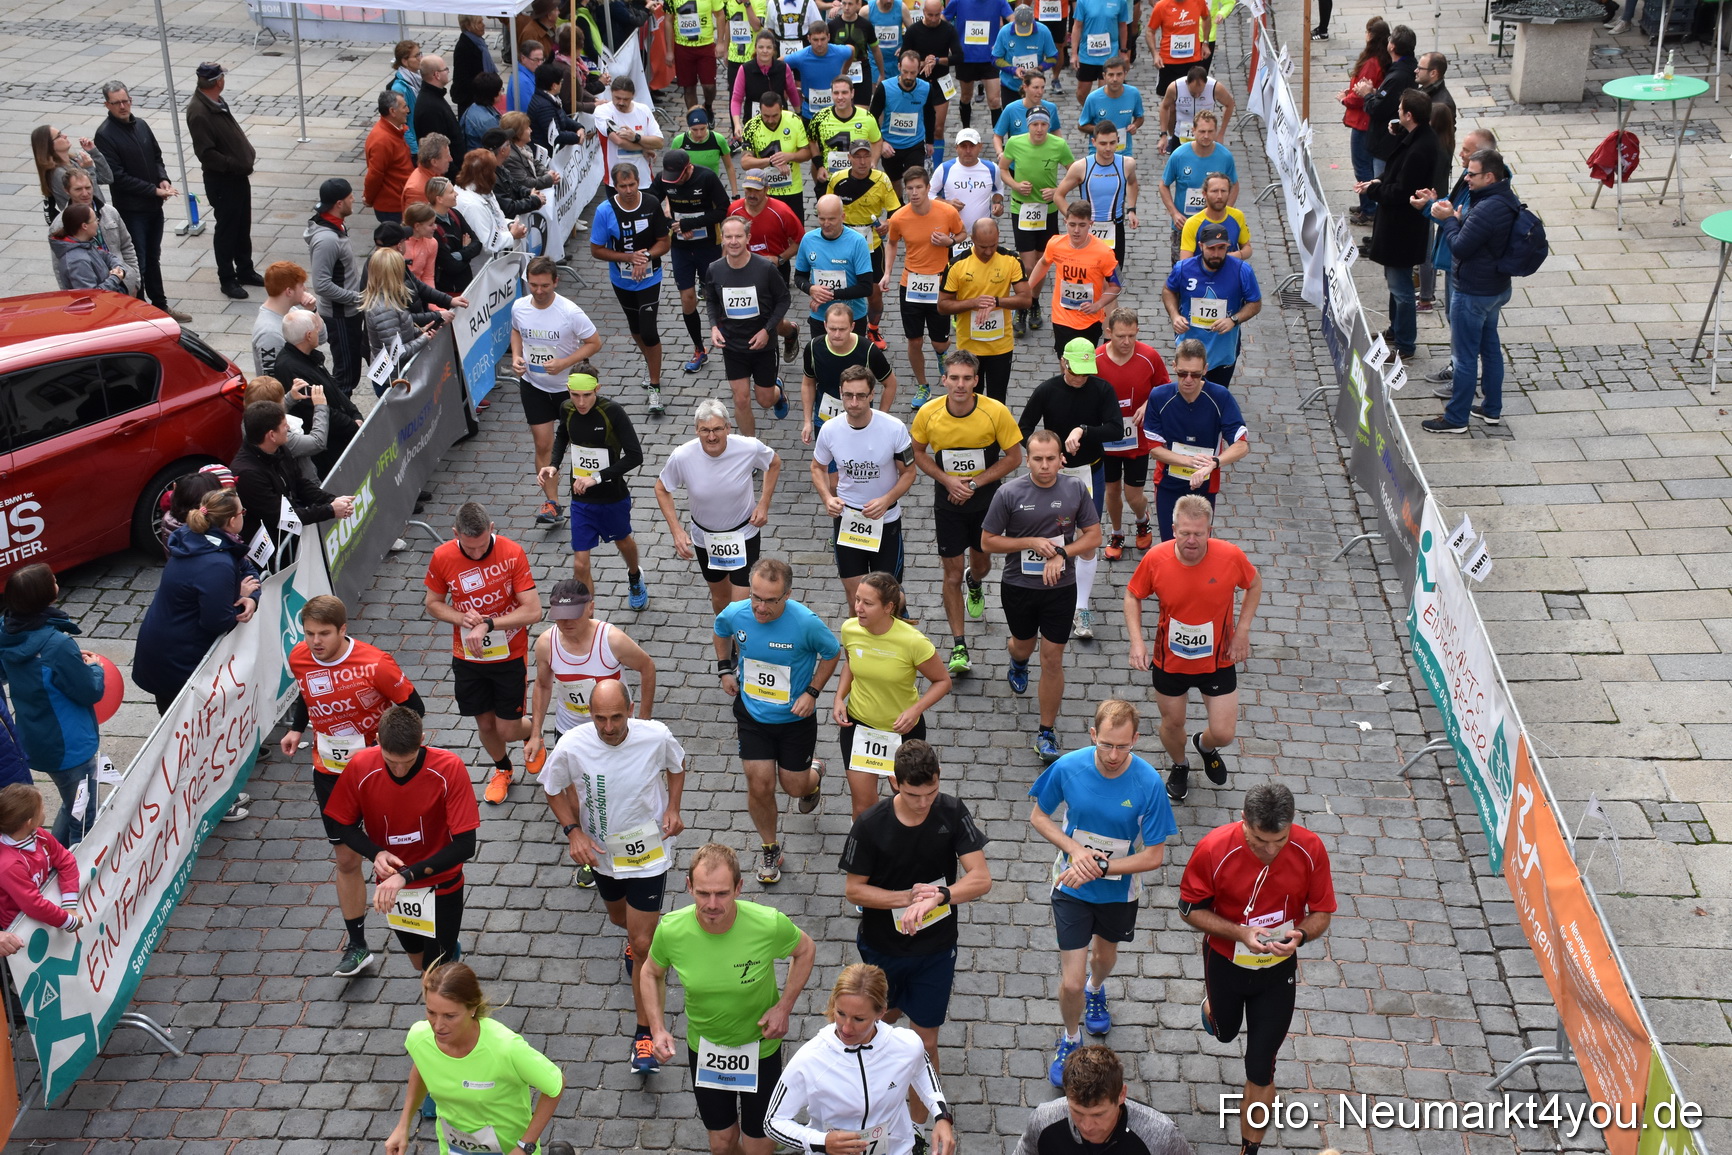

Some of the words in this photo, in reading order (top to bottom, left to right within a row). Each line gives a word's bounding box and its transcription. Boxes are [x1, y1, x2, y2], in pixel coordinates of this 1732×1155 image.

[894, 119, 914, 128] 2653
[768, 174, 788, 182] 2664
[1026, 210, 1042, 220] 236
[1092, 230, 1108, 238] 277
[1063, 264, 1087, 279] RUN
[912, 282, 934, 292] 2457
[1186, 278, 1198, 291] 3
[1064, 289, 1088, 300] 2124
[728, 297, 752, 308] 2737
[1200, 307, 1218, 318] 178
[978, 320, 997, 330] 282
[580, 457, 600, 469] 255
[952, 460, 976, 472] 256
[4, 494, 22, 506] BMW
[23, 492, 34, 500] 1er.
[326, 476, 374, 568] BOCK
[850, 521, 872, 536] 264
[849, 535, 870, 544] Alexander
[254, 541, 266, 560] swn
[710, 544, 740, 556] 2603
[1471, 554, 1488, 574] swn
[1175, 632, 1206, 646] 2540
[758, 672, 776, 687] 59
[569, 692, 586, 704] 61
[758, 688, 776, 697] Thomas
[332, 748, 348, 760] 57
[864, 740, 888, 758] 101
[184, 683, 259, 828] BESSER
[866, 758, 884, 767] Andrea
[582, 773, 598, 838] Naturfreunde
[596, 774, 608, 842] Pommelsbrunn
[625, 840, 646, 856] 95
[626, 854, 650, 865] Siegfried
[395, 901, 422, 918] 189
[402, 918, 420, 928] Markus
[1258, 916, 1274, 925] DEHN
[132, 893, 175, 975] Service-Line:
[1569, 920, 1592, 969] Neumarkts
[706, 1052, 750, 1070] 2580
[718, 1074, 736, 1082] Armin
